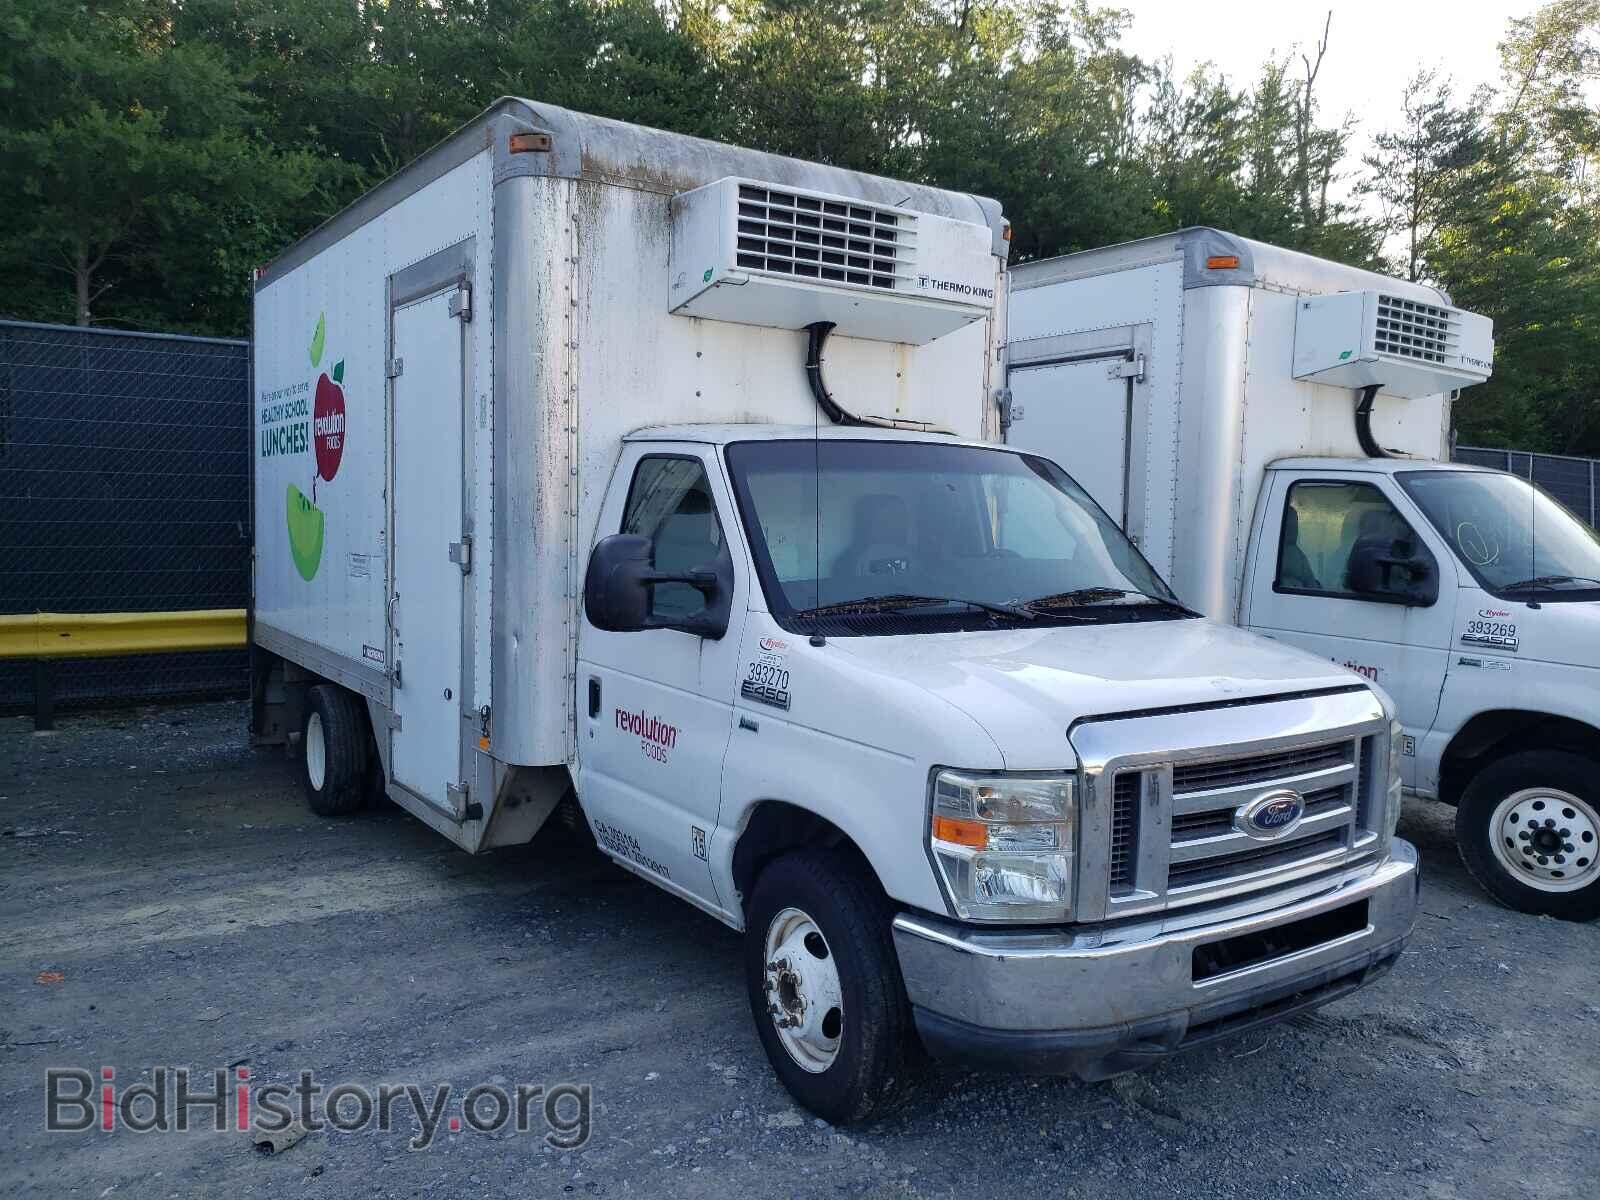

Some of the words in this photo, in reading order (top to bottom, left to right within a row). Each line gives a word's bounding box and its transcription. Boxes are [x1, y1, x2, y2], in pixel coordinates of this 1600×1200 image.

[930, 279, 972, 295] THERMO
[972, 286, 993, 299] KING
[261, 403, 284, 425] HEALTHY
[285, 398, 309, 419] SCHOOL
[314, 408, 345, 437] revolution
[261, 421, 309, 457] LUNCHES!
[326, 435, 341, 450] FOODS
[1467, 620, 1516, 637] 393269
[748, 662, 790, 690] 393270
[615, 708, 676, 749] revolution
[641, 740, 667, 764] FOODS
[1264, 804, 1295, 825] Ford
[694, 835, 705, 858] 15
